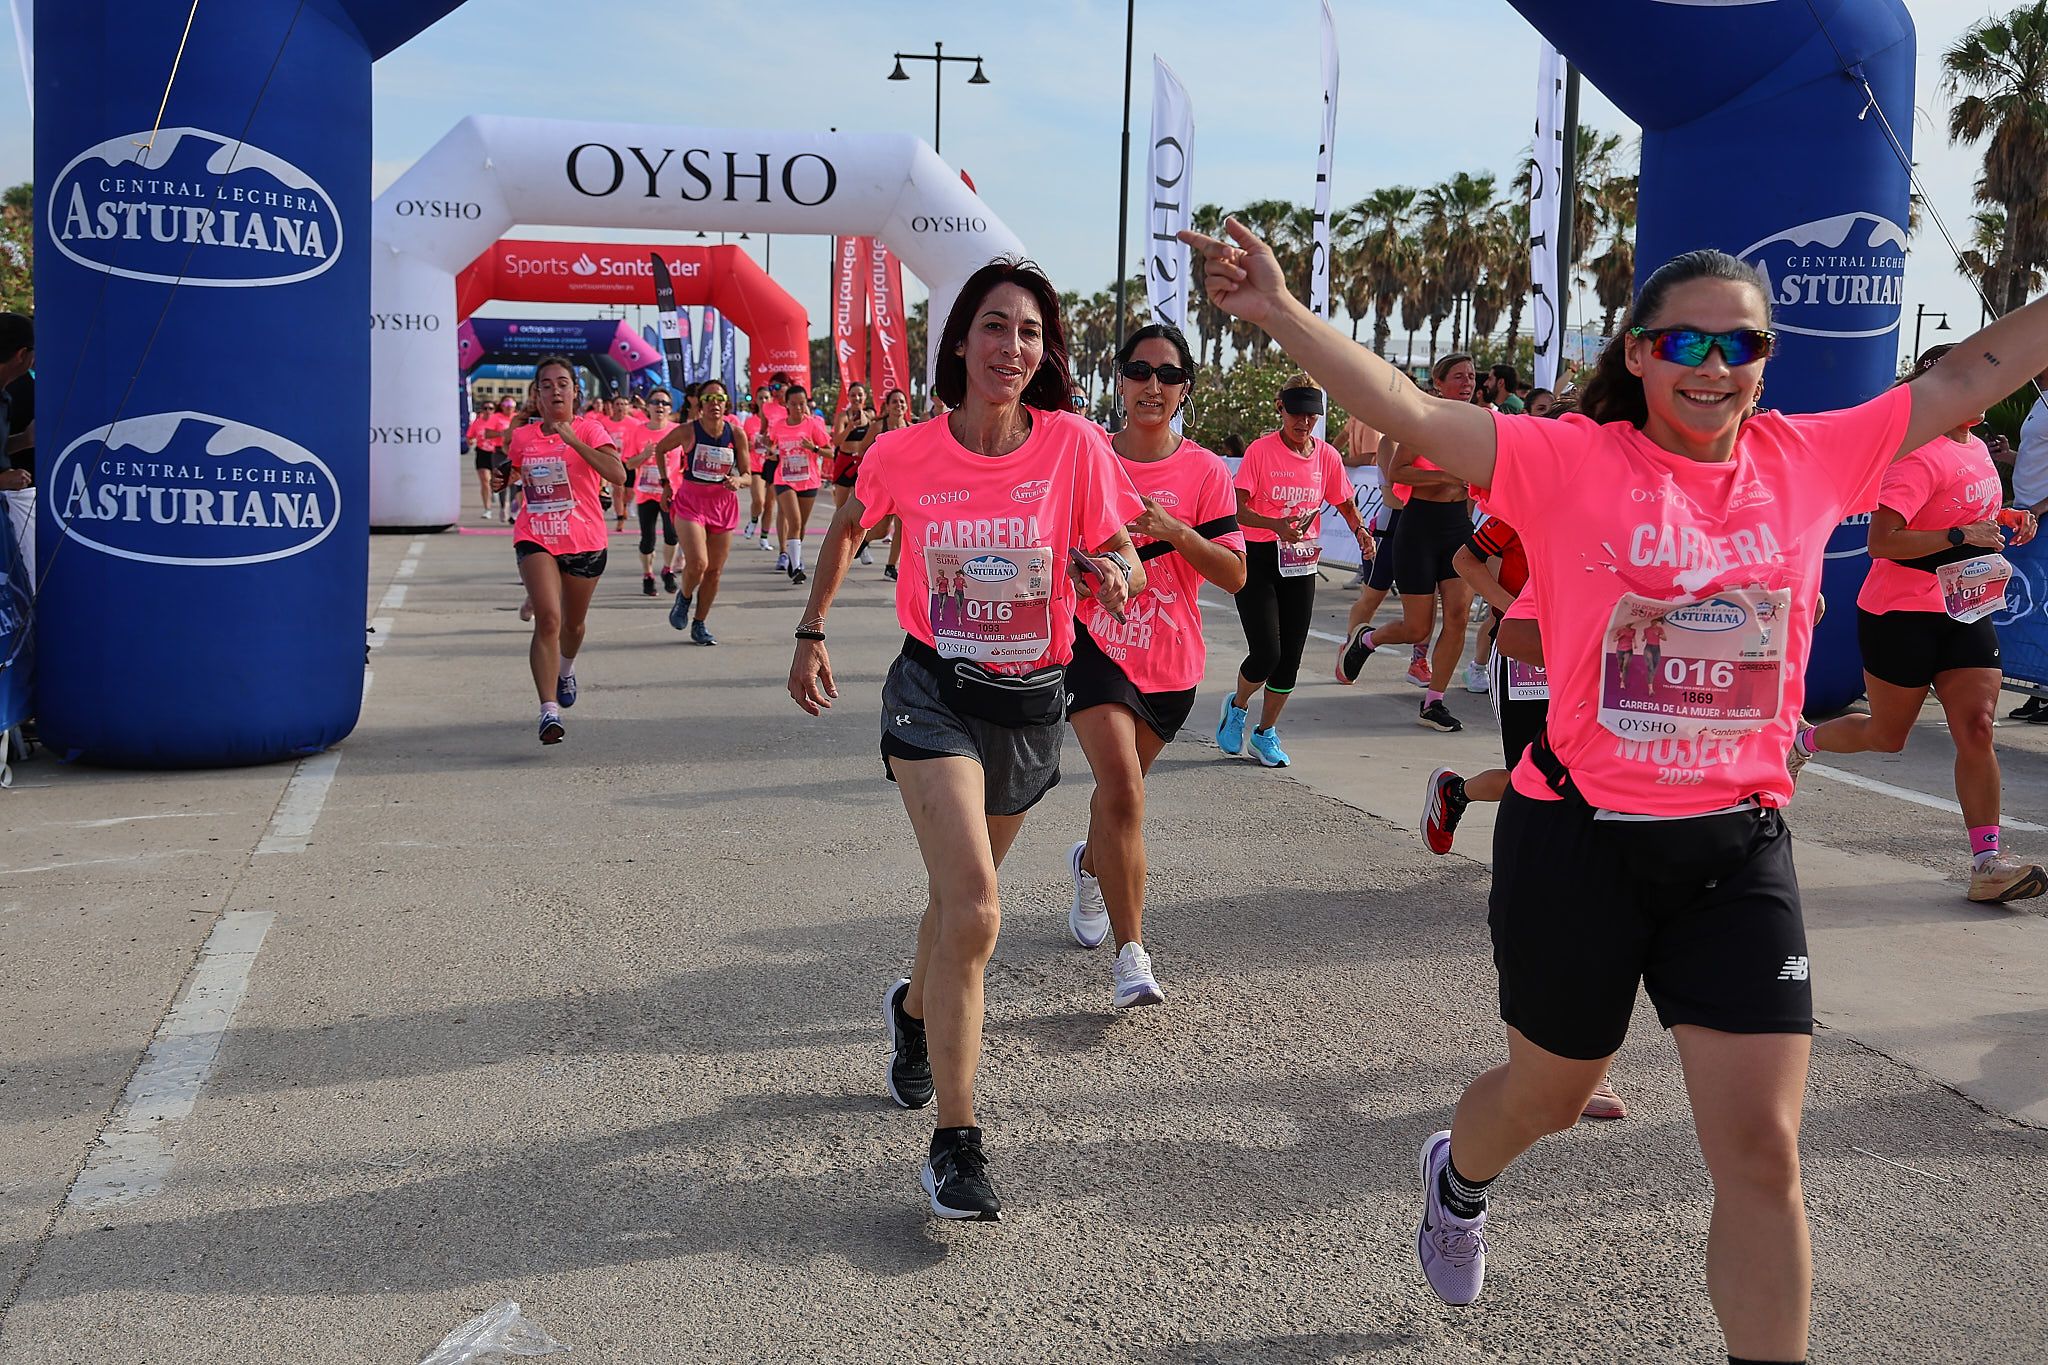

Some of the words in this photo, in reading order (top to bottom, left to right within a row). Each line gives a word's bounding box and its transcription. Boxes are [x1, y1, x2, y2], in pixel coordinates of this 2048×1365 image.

[566, 143, 837, 206] OYSHO
[100, 178, 204, 198] CENTRAL
[217, 186, 318, 213] LECHERA
[396, 200, 482, 220] OYSHO
[61, 181, 327, 259] ASTURIANA
[912, 216, 987, 234] OYSHO
[505, 254, 569, 277] Sports
[1787, 256, 1866, 269] CENTRAL
[100, 461, 204, 480] CENTRAL
[217, 466, 317, 485] LECHERA
[62, 462, 325, 529] ASTURIANA
[536, 484, 554, 494] 016
[919, 489, 970, 506] OYSHO
[925, 515, 1042, 549] CARRERA
[1295, 547, 1314, 557] 016
[966, 565, 1015, 577] ASTURIANA
[1963, 583, 1987, 601] 016
[967, 600, 1013, 621] 016
[1669, 610, 1740, 625] ASTURIANA
[938, 628, 966, 639] CARRERA
[976, 632, 983, 640] LA
[1010, 631, 1038, 641] VALENCIA
[978, 623, 1000, 633] 1093
[1089, 610, 1153, 650] MUJER
[938, 642, 977, 655] OYSHO
[1001, 647, 1039, 656] Santander
[1105, 644, 1127, 661] 2026
[1664, 658, 1735, 688] 016
[1518, 688, 1545, 697] OYSHO
[1682, 691, 1714, 705] 1869
[1619, 699, 1660, 712] CARRERA
[1662, 703, 1674, 713] DE
[1676, 704, 1688, 715] LA
[1690, 707, 1720, 717] MUJER
[1726, 708, 1761, 718] VALENCIA
[1618, 717, 1676, 734] OYSHO
[1655, 767, 1705, 786] 2026
